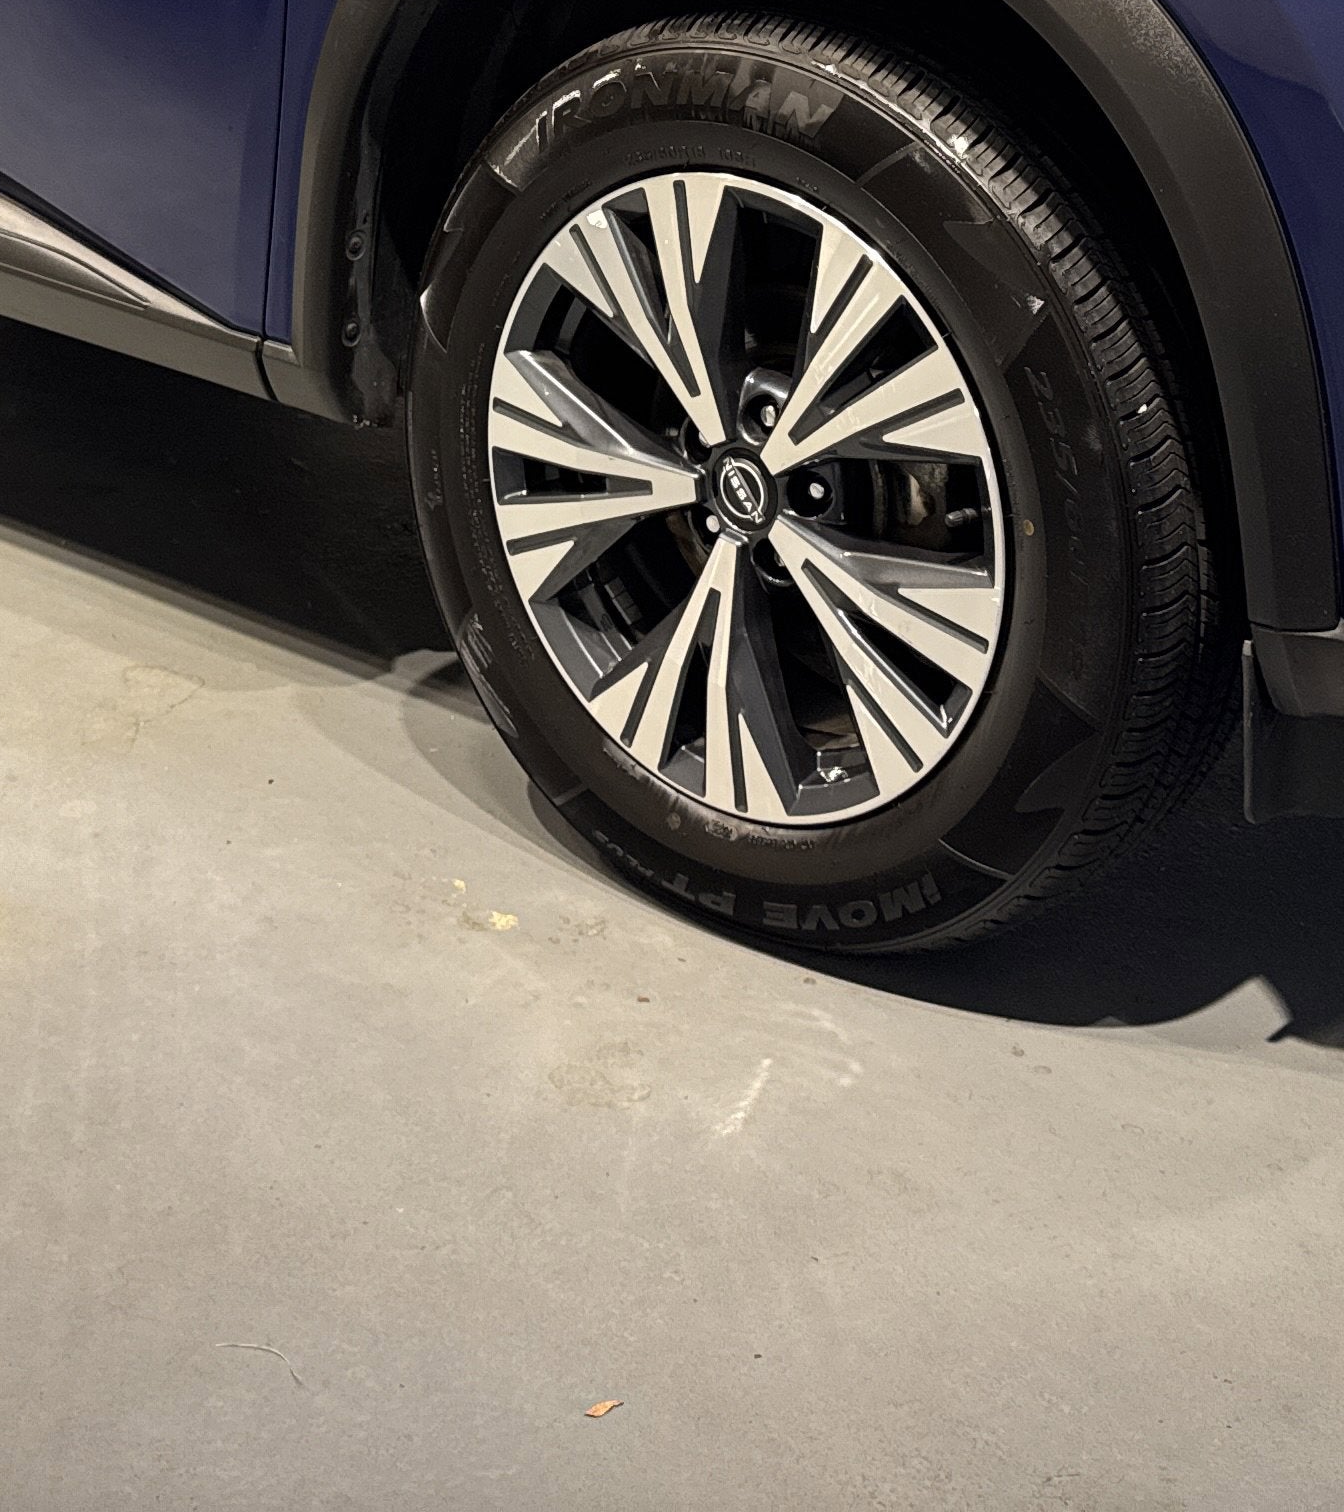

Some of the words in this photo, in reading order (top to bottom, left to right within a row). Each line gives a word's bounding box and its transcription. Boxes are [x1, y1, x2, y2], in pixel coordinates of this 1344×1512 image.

[535, 69, 835, 151] IRONMAN
[723, 456, 765, 523] NISSAN
[661, 872, 738, 917] PT
[762, 870, 942, 931] iMOVE
